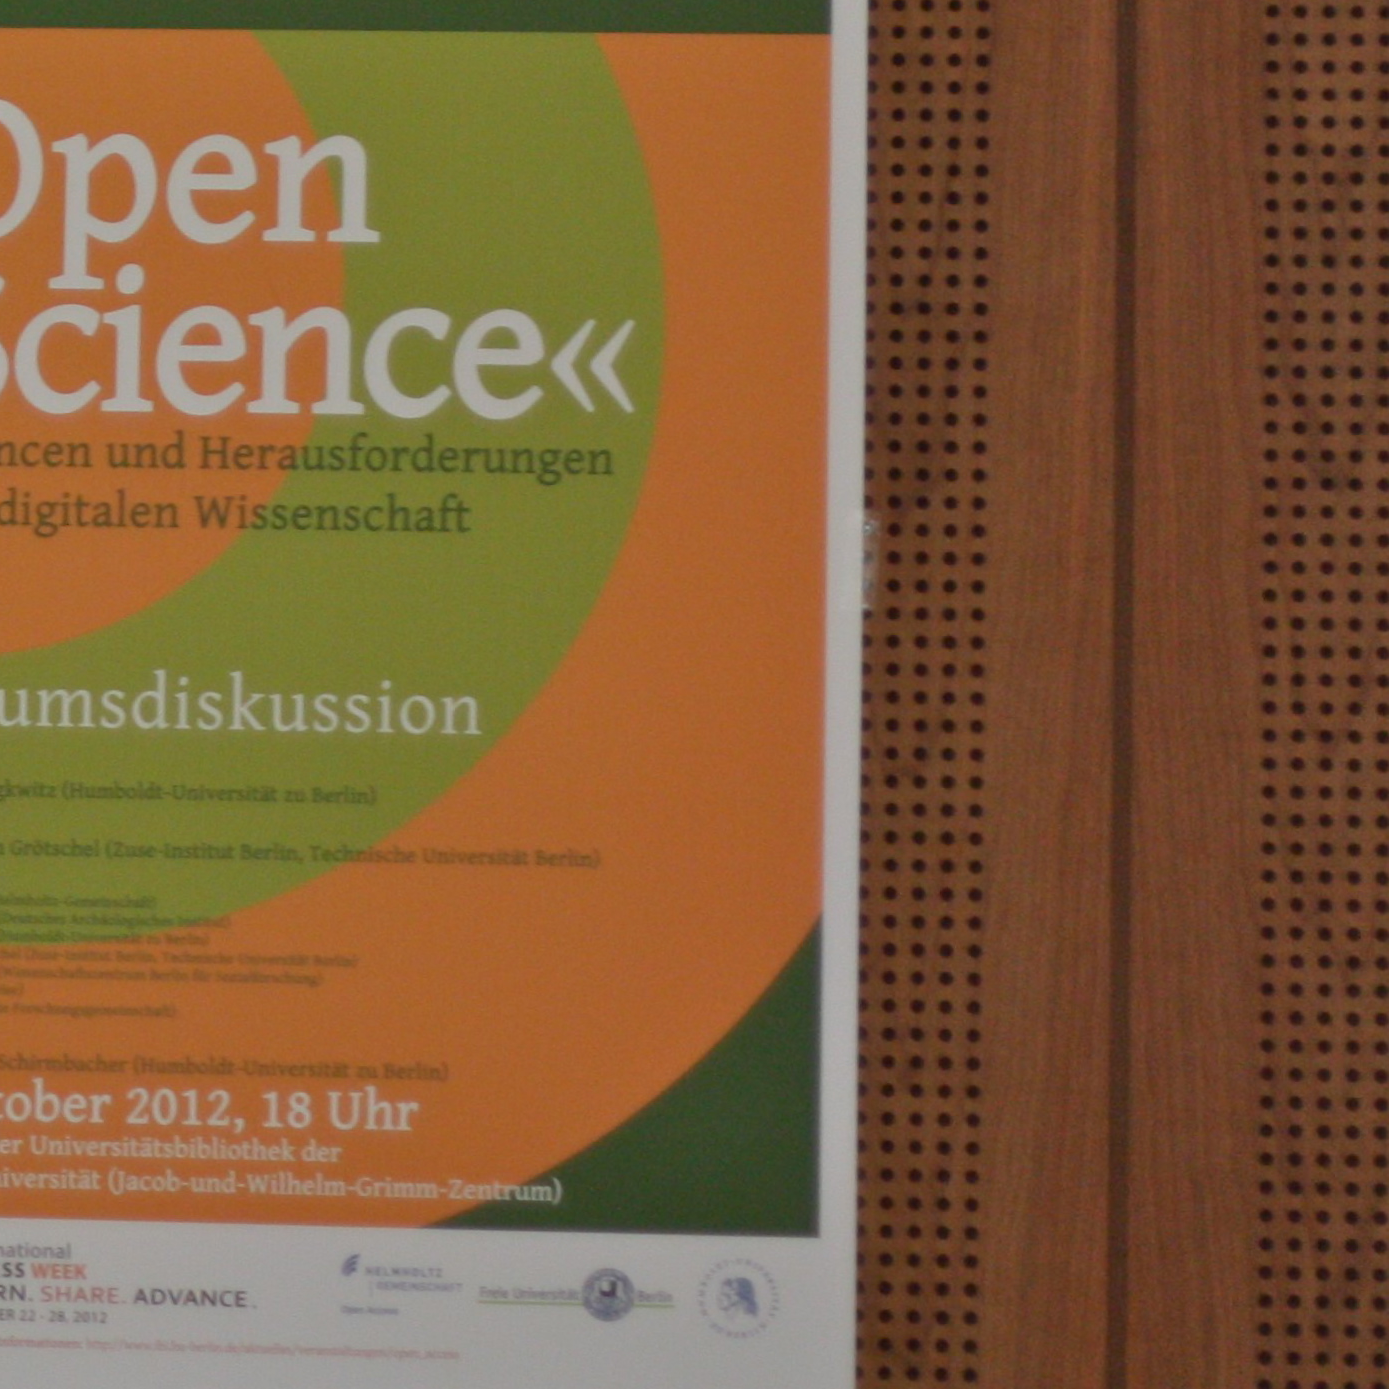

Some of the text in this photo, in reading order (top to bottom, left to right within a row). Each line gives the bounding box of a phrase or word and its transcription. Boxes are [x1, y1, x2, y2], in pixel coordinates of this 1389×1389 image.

[107, 431, 186, 471] und
[197, 434, 613, 486] Herausforderungen
[194, 492, 471, 534] Wissenschaft
[62, 780, 277, 804] (Humboldt-Universität
[284, 789, 306, 803] zu
[312, 785, 379, 806] Berlin)
[10, 838, 99, 857] Grötschel
[240, 844, 304, 863] Berlin,
[310, 845, 415, 864] Technische
[423, 847, 528, 866] Universität
[535, 849, 601, 870] Berlin)
[132, 1054, 350, 1080] (Humboldt-Universität
[356, 1065, 379, 1080] zu
[383, 1061, 449, 1083] Berlin)
[126, 1089, 246, 1133] 2012,
[263, 1092, 311, 1128] 18
[328, 1086, 420, 1132] Uhr
[29, 1134, 296, 1163] Universitätsbibliothek
[302, 1141, 342, 1164] der
[107, 1167, 563, 1205] (Jacob-und-Wilhelm-Grimm-Zentrum)
[30, 1263, 88, 1280] WEEK
[364, 1266, 443, 1278] HELMHOLTZ
[40, 1285, 127, 1304] SHARE.
[133, 1289, 258, 1310] ADVANCE.
[478, 1285, 673, 1301] Freie Universität Berlin
[19, 1308, 37, 1322] 22
[73, 1310, 109, 1324] 2012
